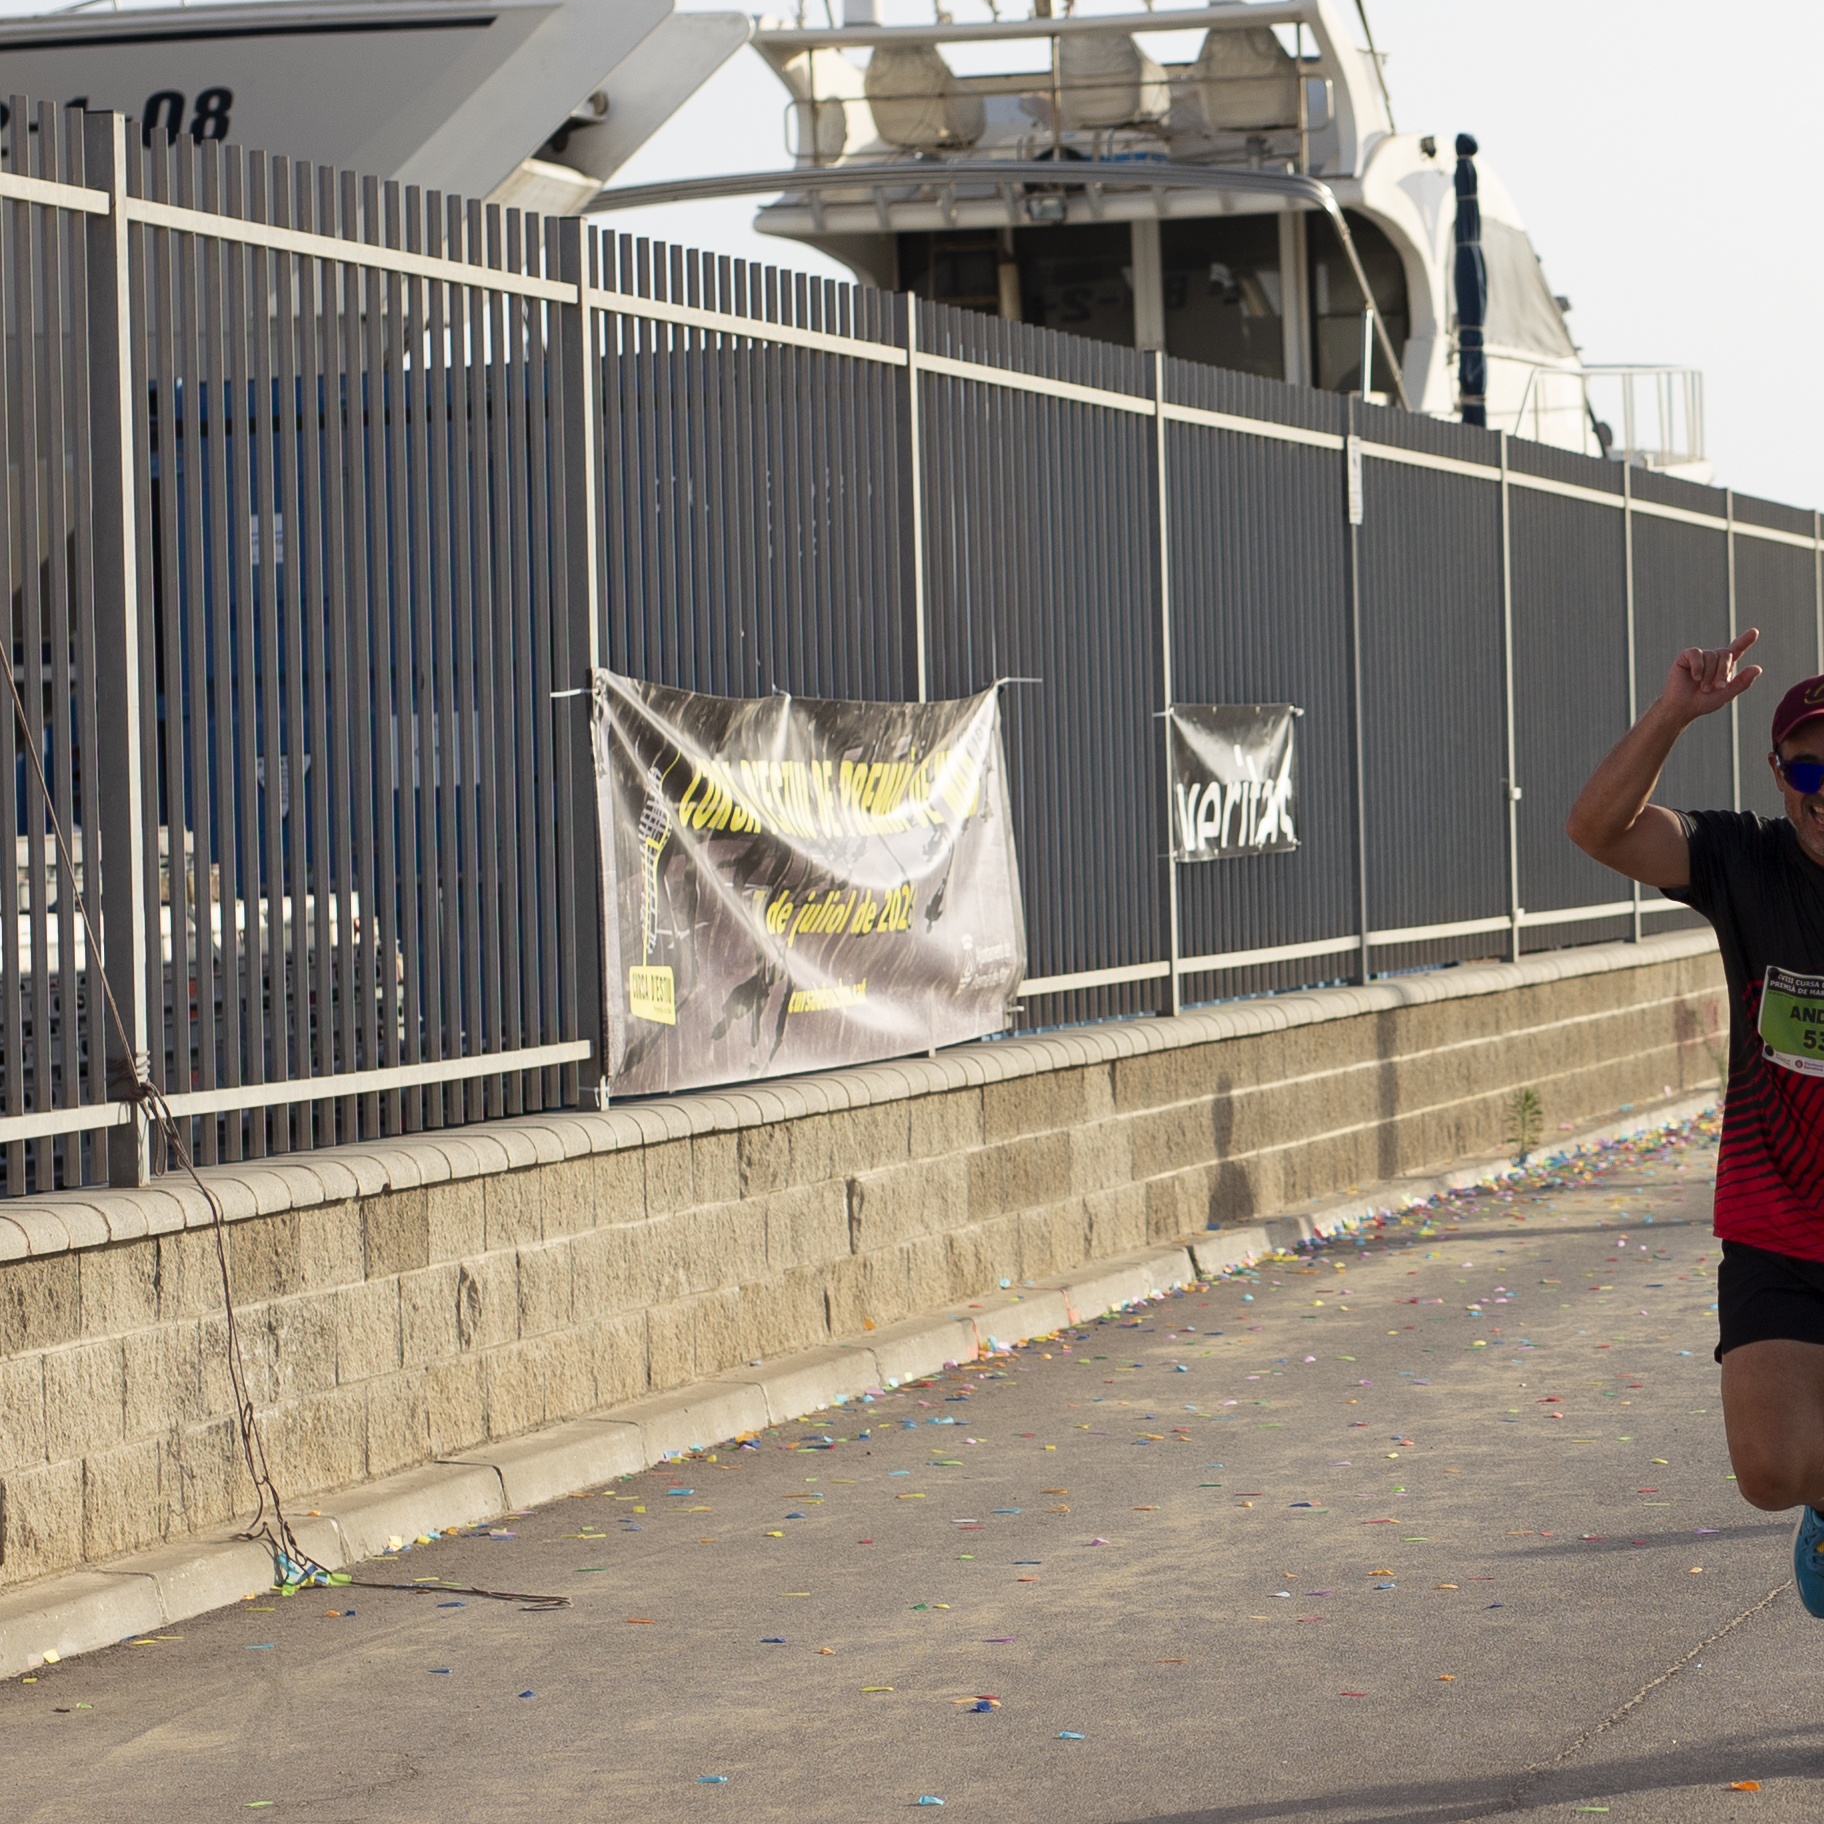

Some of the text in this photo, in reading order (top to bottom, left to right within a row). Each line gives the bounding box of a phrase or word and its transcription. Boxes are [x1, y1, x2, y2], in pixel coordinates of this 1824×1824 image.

[766, 889, 794, 935] de
[787, 889, 858, 948] juliol
[850, 888, 878, 934] de
